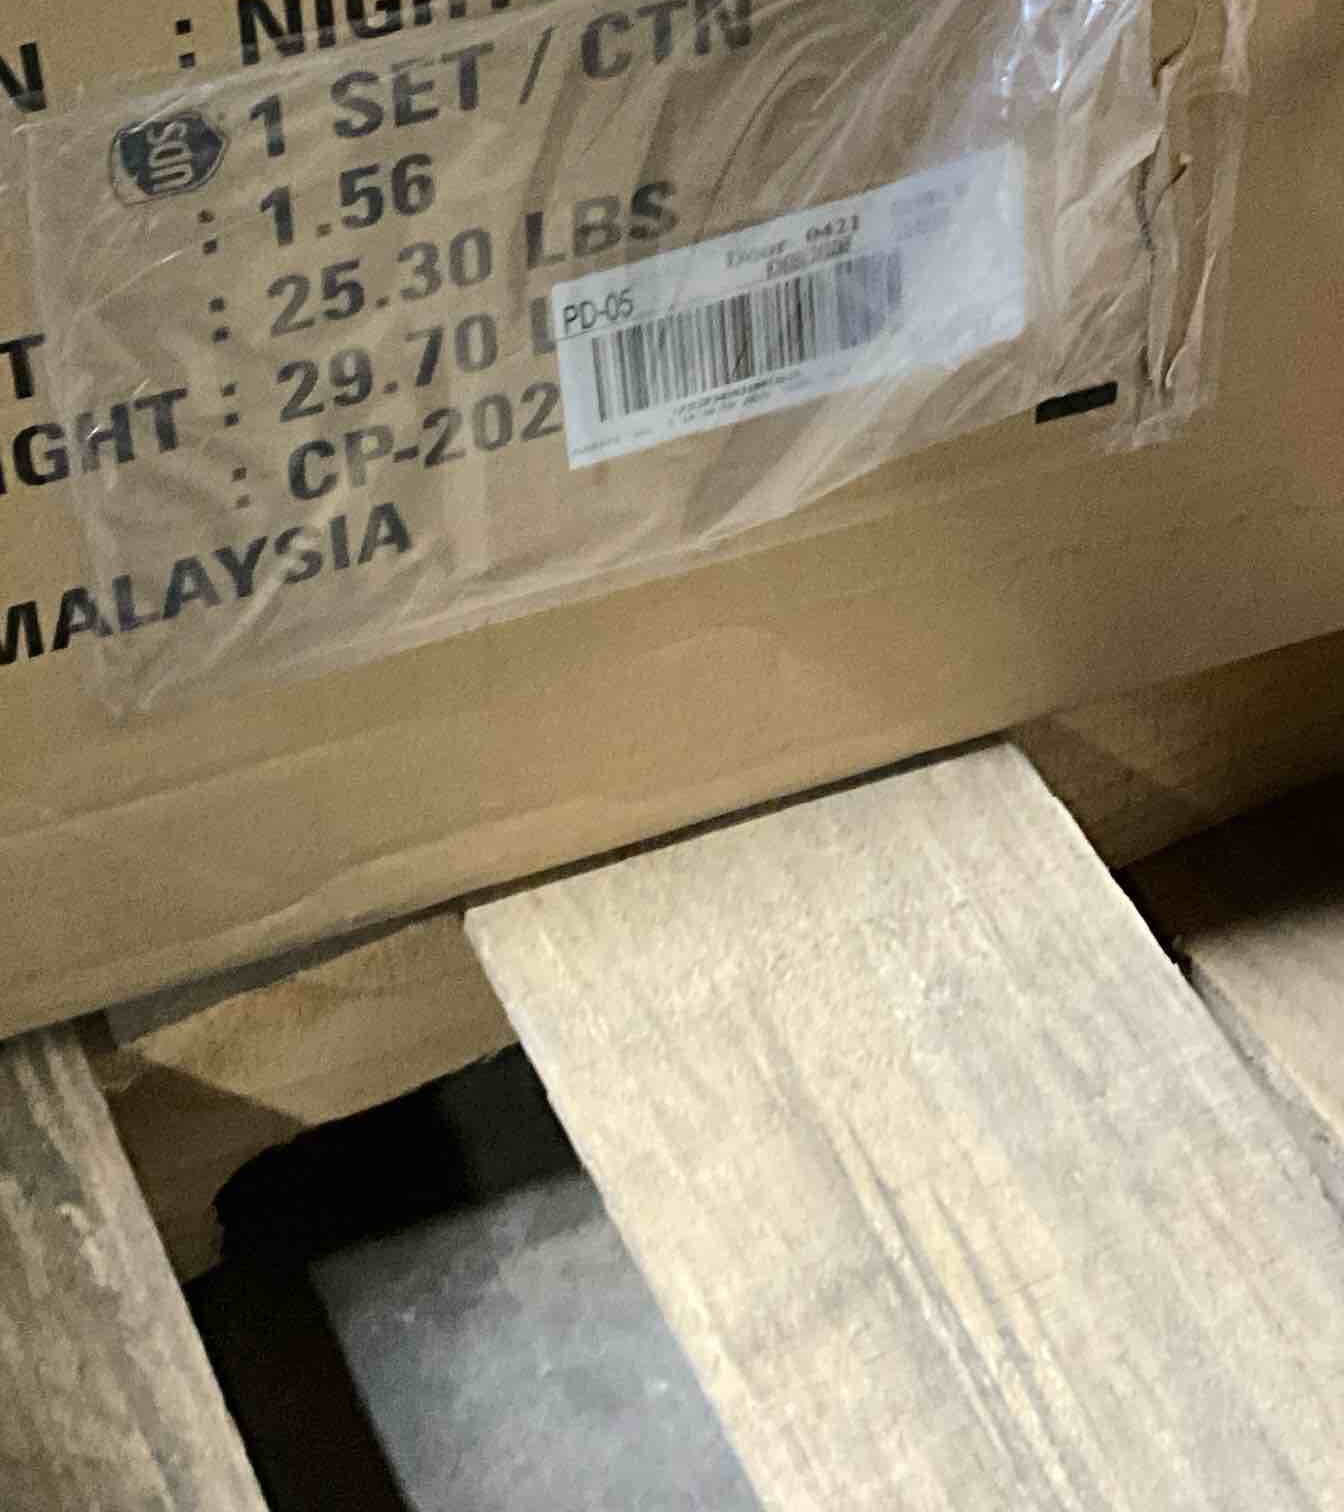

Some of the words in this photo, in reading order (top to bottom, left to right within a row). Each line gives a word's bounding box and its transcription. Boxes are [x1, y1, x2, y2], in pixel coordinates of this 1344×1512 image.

[247, 93, 288, 160] 1
[330, 40, 496, 140] SET
[258, 151, 437, 250] 1.56
[266, 227, 493, 338] 25.30
[524, 180, 681, 270] LBS
[275, 310, 500, 425] 29.70
